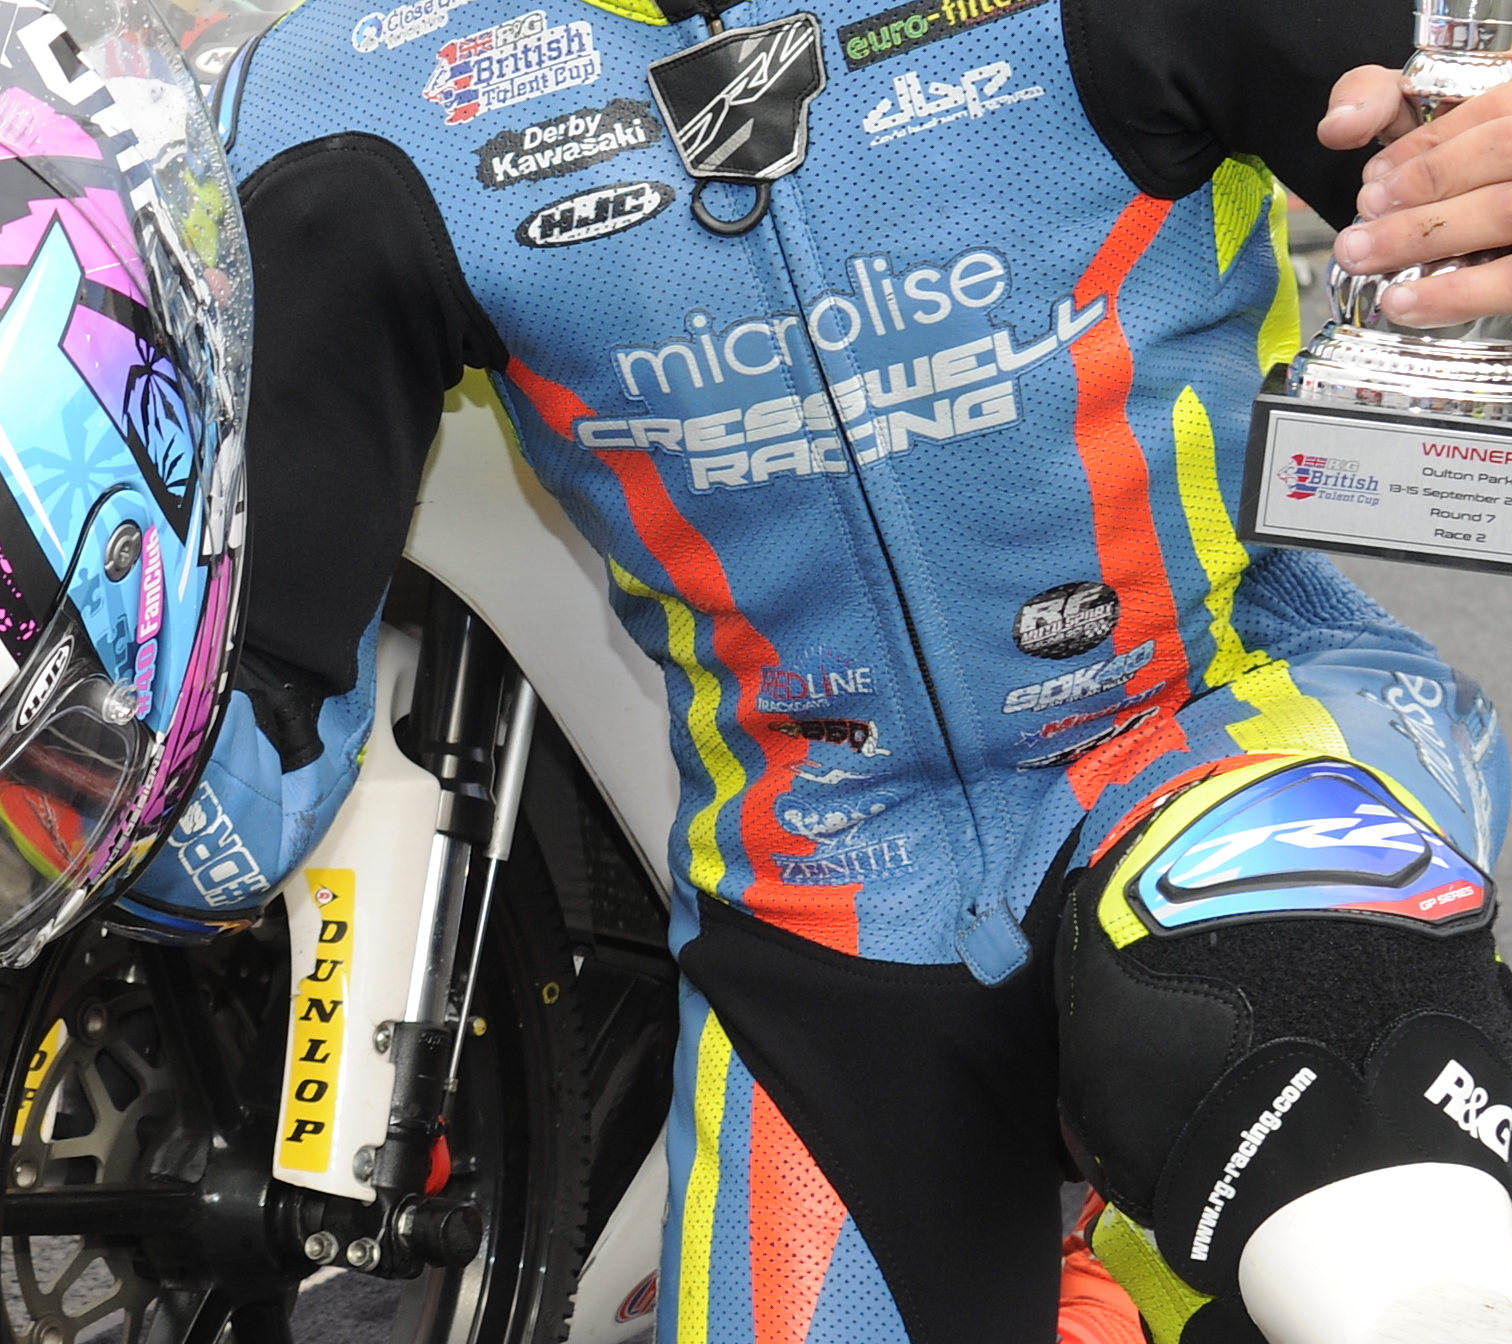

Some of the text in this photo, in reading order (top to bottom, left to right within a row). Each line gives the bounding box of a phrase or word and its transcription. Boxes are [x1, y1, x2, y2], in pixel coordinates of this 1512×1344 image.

[387, 1, 434, 33] Close
[495, 13, 543, 49] R&G
[474, 27, 586, 86] British
[482, 59, 596, 108] Talent Cup
[491, 118, 647, 183] Kawasaki
[523, 112, 603, 151] Derby
[539, 184, 647, 240] HJC
[614, 250, 1007, 397] microlise
[576, 293, 1108, 453] CRESSWELL
[688, 380, 1015, 492] RACING
[1309, 470, 1380, 492] British
[1327, 457, 1360, 472] R&G
[1421, 466, 1474, 483] Oulton
[1317, 489, 1380, 507] Talent Cup
[1388, 482, 1420, 497] 13-15
[1421, 486, 1500, 506] September
[1429, 507, 1496, 524] Round 7
[1433, 527, 1487, 544] Race 2
[134, 524, 163, 722] #40 FanClub
[23, 644, 72, 722] HJC
[761, 662, 874, 701] REDLINE
[776, 838, 914, 879] ZENITH
[1419, 885, 1475, 912] GP SERIES
[285, 919, 349, 1144] DUNLOP
[1190, 1066, 1318, 1262] www.rg-racing.com
